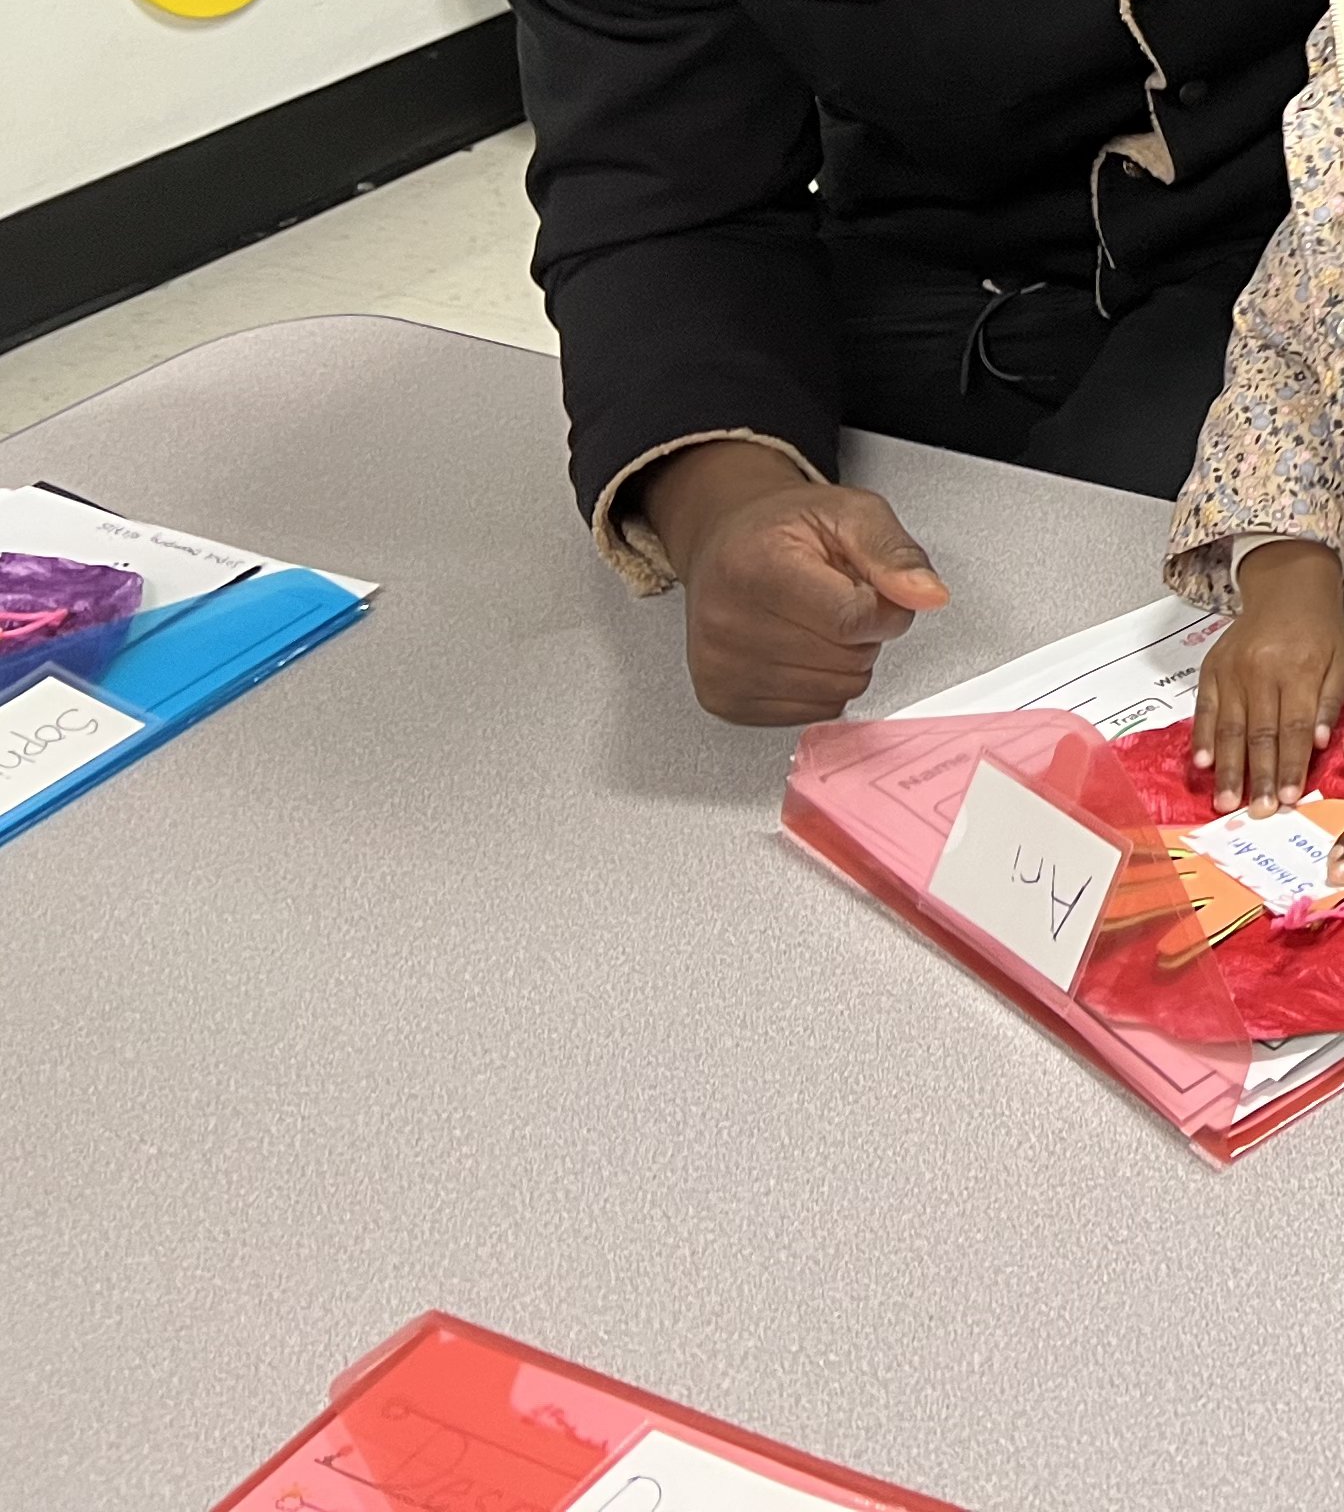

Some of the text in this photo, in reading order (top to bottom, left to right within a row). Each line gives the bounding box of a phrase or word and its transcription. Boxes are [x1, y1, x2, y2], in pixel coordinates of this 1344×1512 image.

[897, 752, 971, 790] Name
[1226, 838, 1314, 895] 5 things Ari
[1288, 833, 1327, 865] loves
[1010, 844, 1093, 942] Ari
